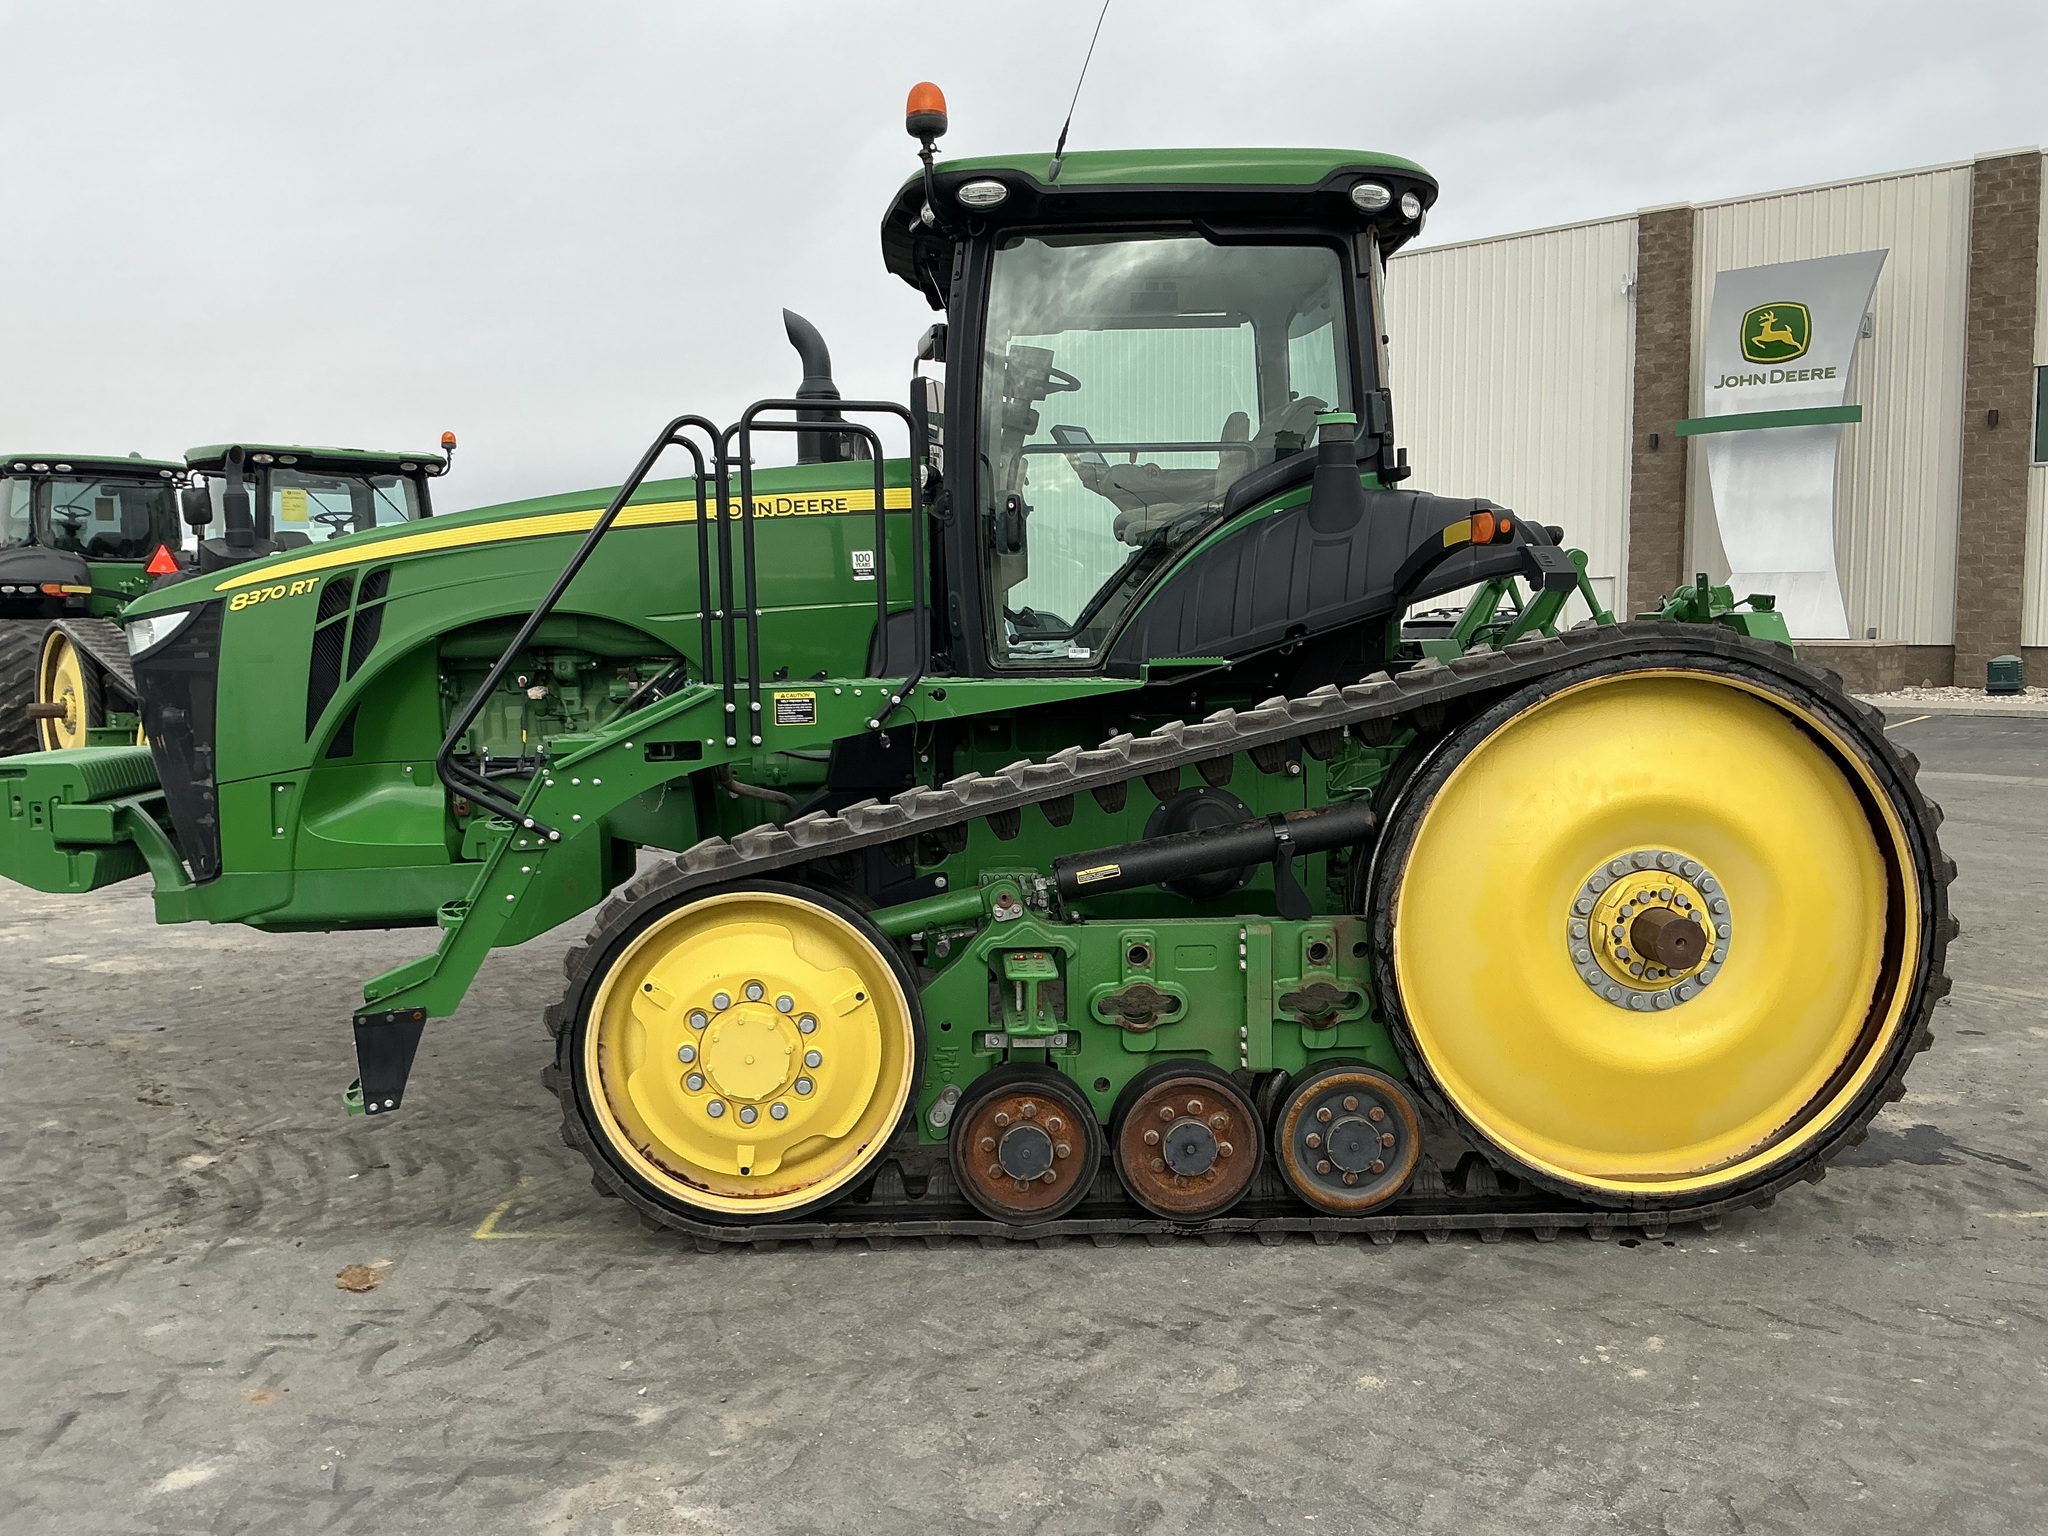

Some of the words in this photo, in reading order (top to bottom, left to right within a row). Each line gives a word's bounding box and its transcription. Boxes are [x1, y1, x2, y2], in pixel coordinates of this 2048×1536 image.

[1713, 372, 1767, 390] JOHN
[1769, 366, 1837, 385] DEERE
[776, 497, 848, 515] DEERE
[854, 553, 871, 563] 100
[229, 584, 287, 612] 8370
[288, 577, 320, 597] RT
